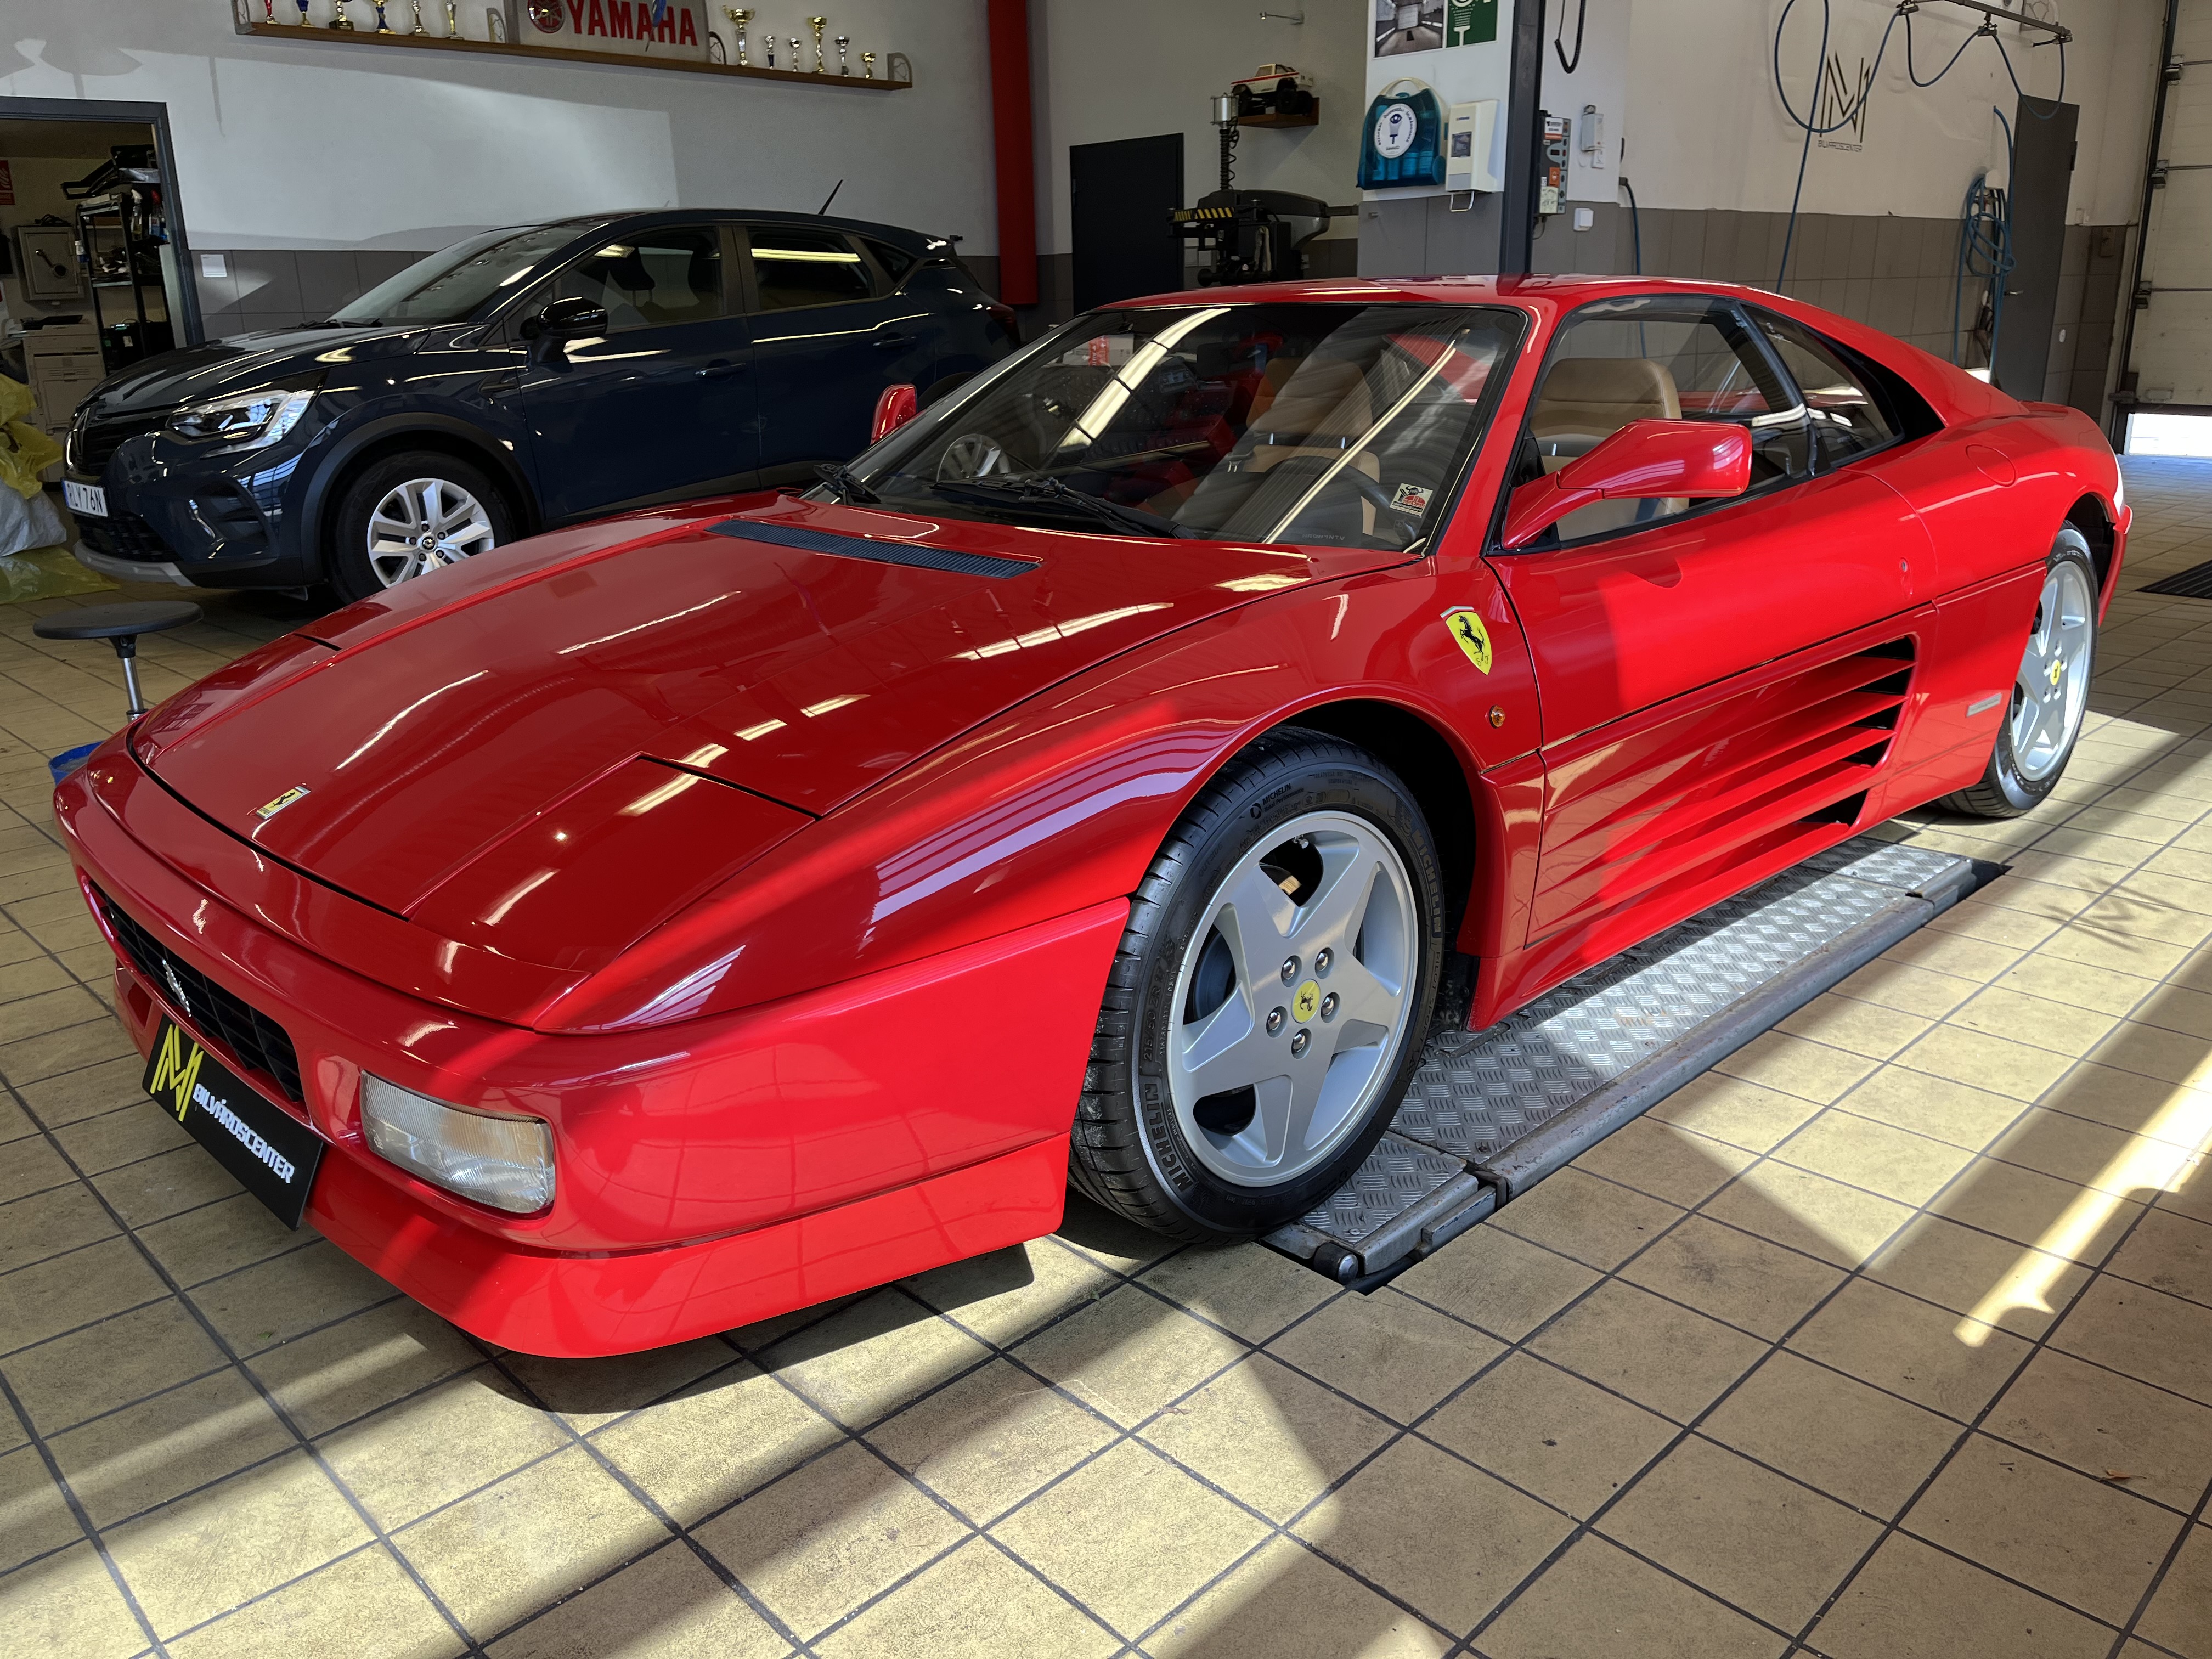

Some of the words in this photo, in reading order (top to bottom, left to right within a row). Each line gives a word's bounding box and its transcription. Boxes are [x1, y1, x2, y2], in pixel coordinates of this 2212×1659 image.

[567, 0, 698, 46] YAMAHA
[1262, 783, 1291, 806] MICHELIN
[1264, 802, 1276, 812] Total
[1276, 788, 1305, 803] Performance
[1411, 829, 1442, 933] MICHELIN
[1432, 951, 1441, 989] PILOT
[1143, 1011, 1156, 1062] 215/50
[1419, 997, 1435, 1042] SPORT
[193, 1083, 295, 1184] BILVÅRDSCENTER
[1144, 1083, 1193, 1192] MICHELIN
